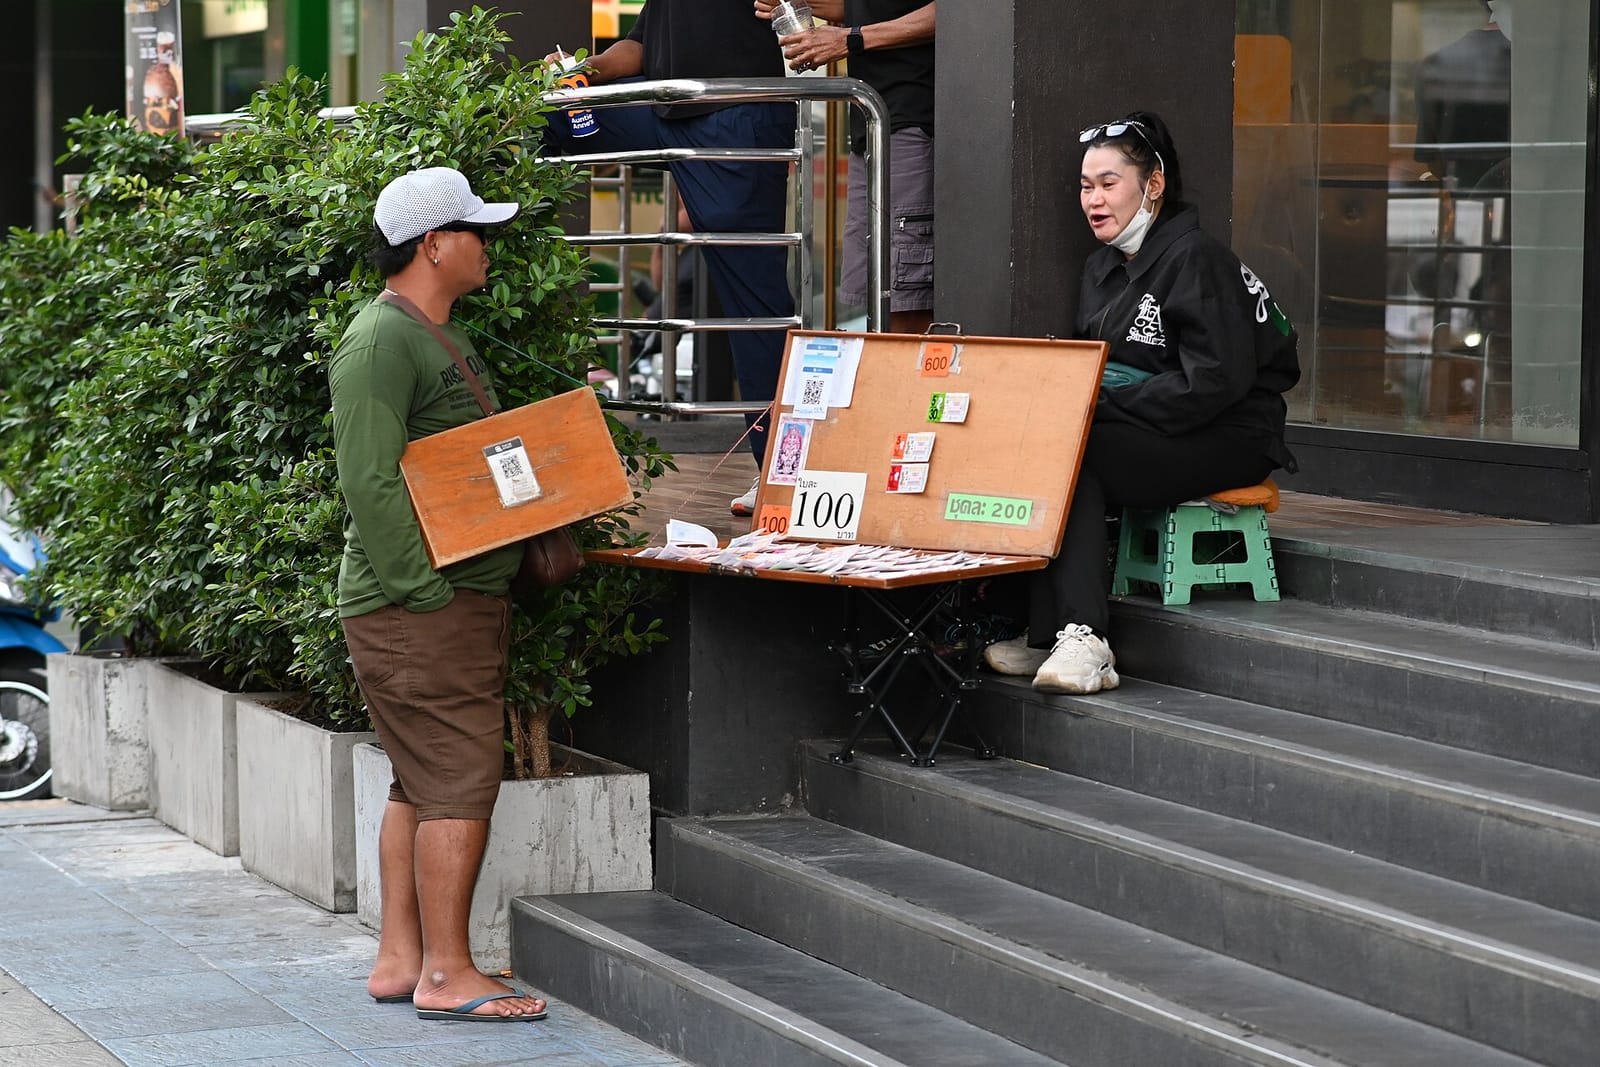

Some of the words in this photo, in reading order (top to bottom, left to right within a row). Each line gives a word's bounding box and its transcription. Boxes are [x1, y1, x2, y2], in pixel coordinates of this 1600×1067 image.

[572, 114, 592, 124] Auntie
[573, 119, 594, 128] Anne's
[925, 356, 948, 372] 600
[928, 408, 939, 420] 30
[798, 477, 818, 488] ใบละ
[794, 491, 854, 529] 100
[950, 498, 987, 519] ชุดละ
[991, 502, 1027, 520] 200
[761, 516, 787, 534] 100
